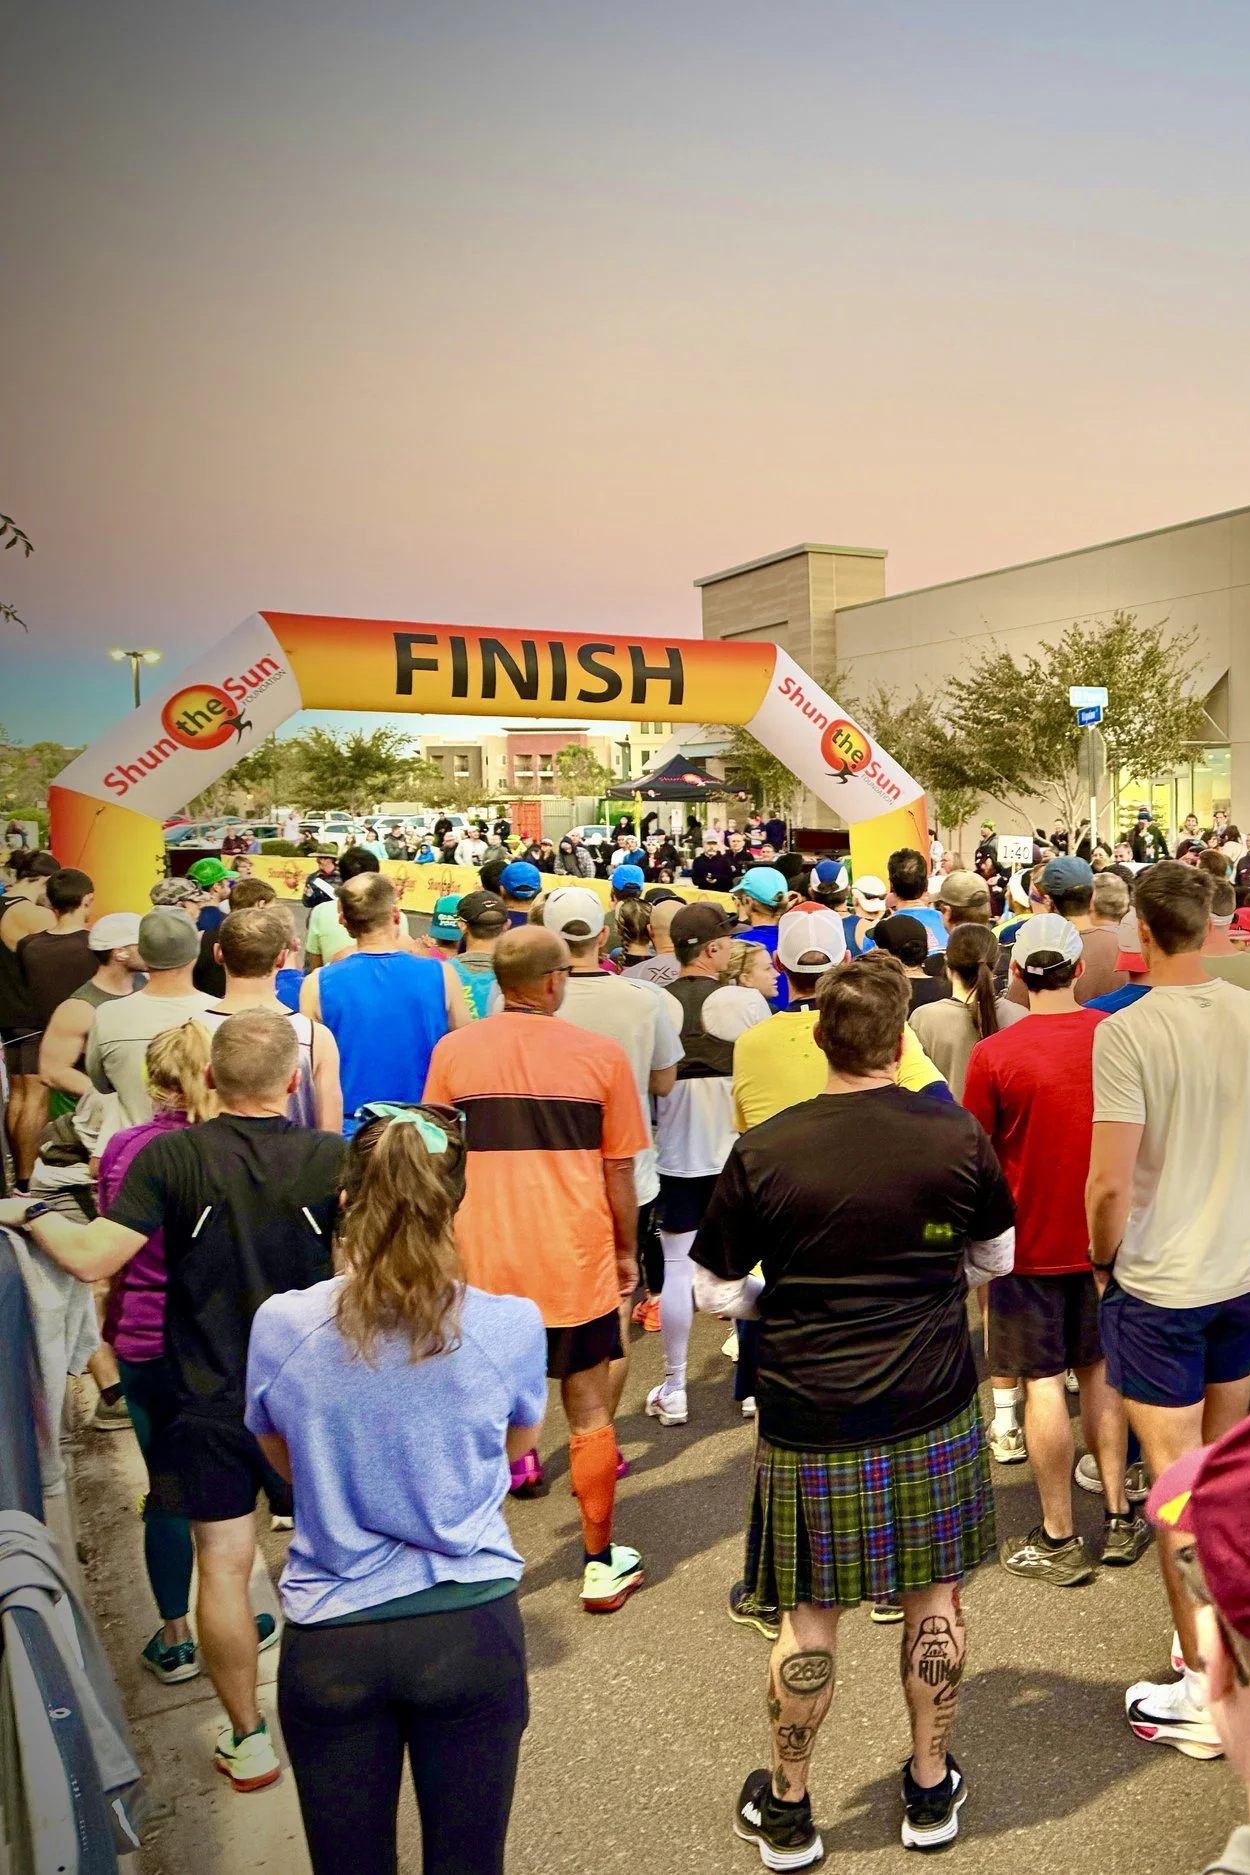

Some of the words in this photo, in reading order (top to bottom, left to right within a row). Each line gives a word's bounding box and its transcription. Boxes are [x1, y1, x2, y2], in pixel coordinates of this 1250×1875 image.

[241, 668, 287, 706] FOUNDATION
[393, 632, 684, 705] FINISH
[103, 737, 179, 797] Shun
[175, 698, 227, 737] the
[222, 656, 281, 701] Sun
[777, 676, 828, 730] Shun
[832, 728, 864, 765] the
[865, 761, 901, 801] Sun
[1003, 845, 1031, 860] 1:40
[918, 1658, 951, 1687] RUN
